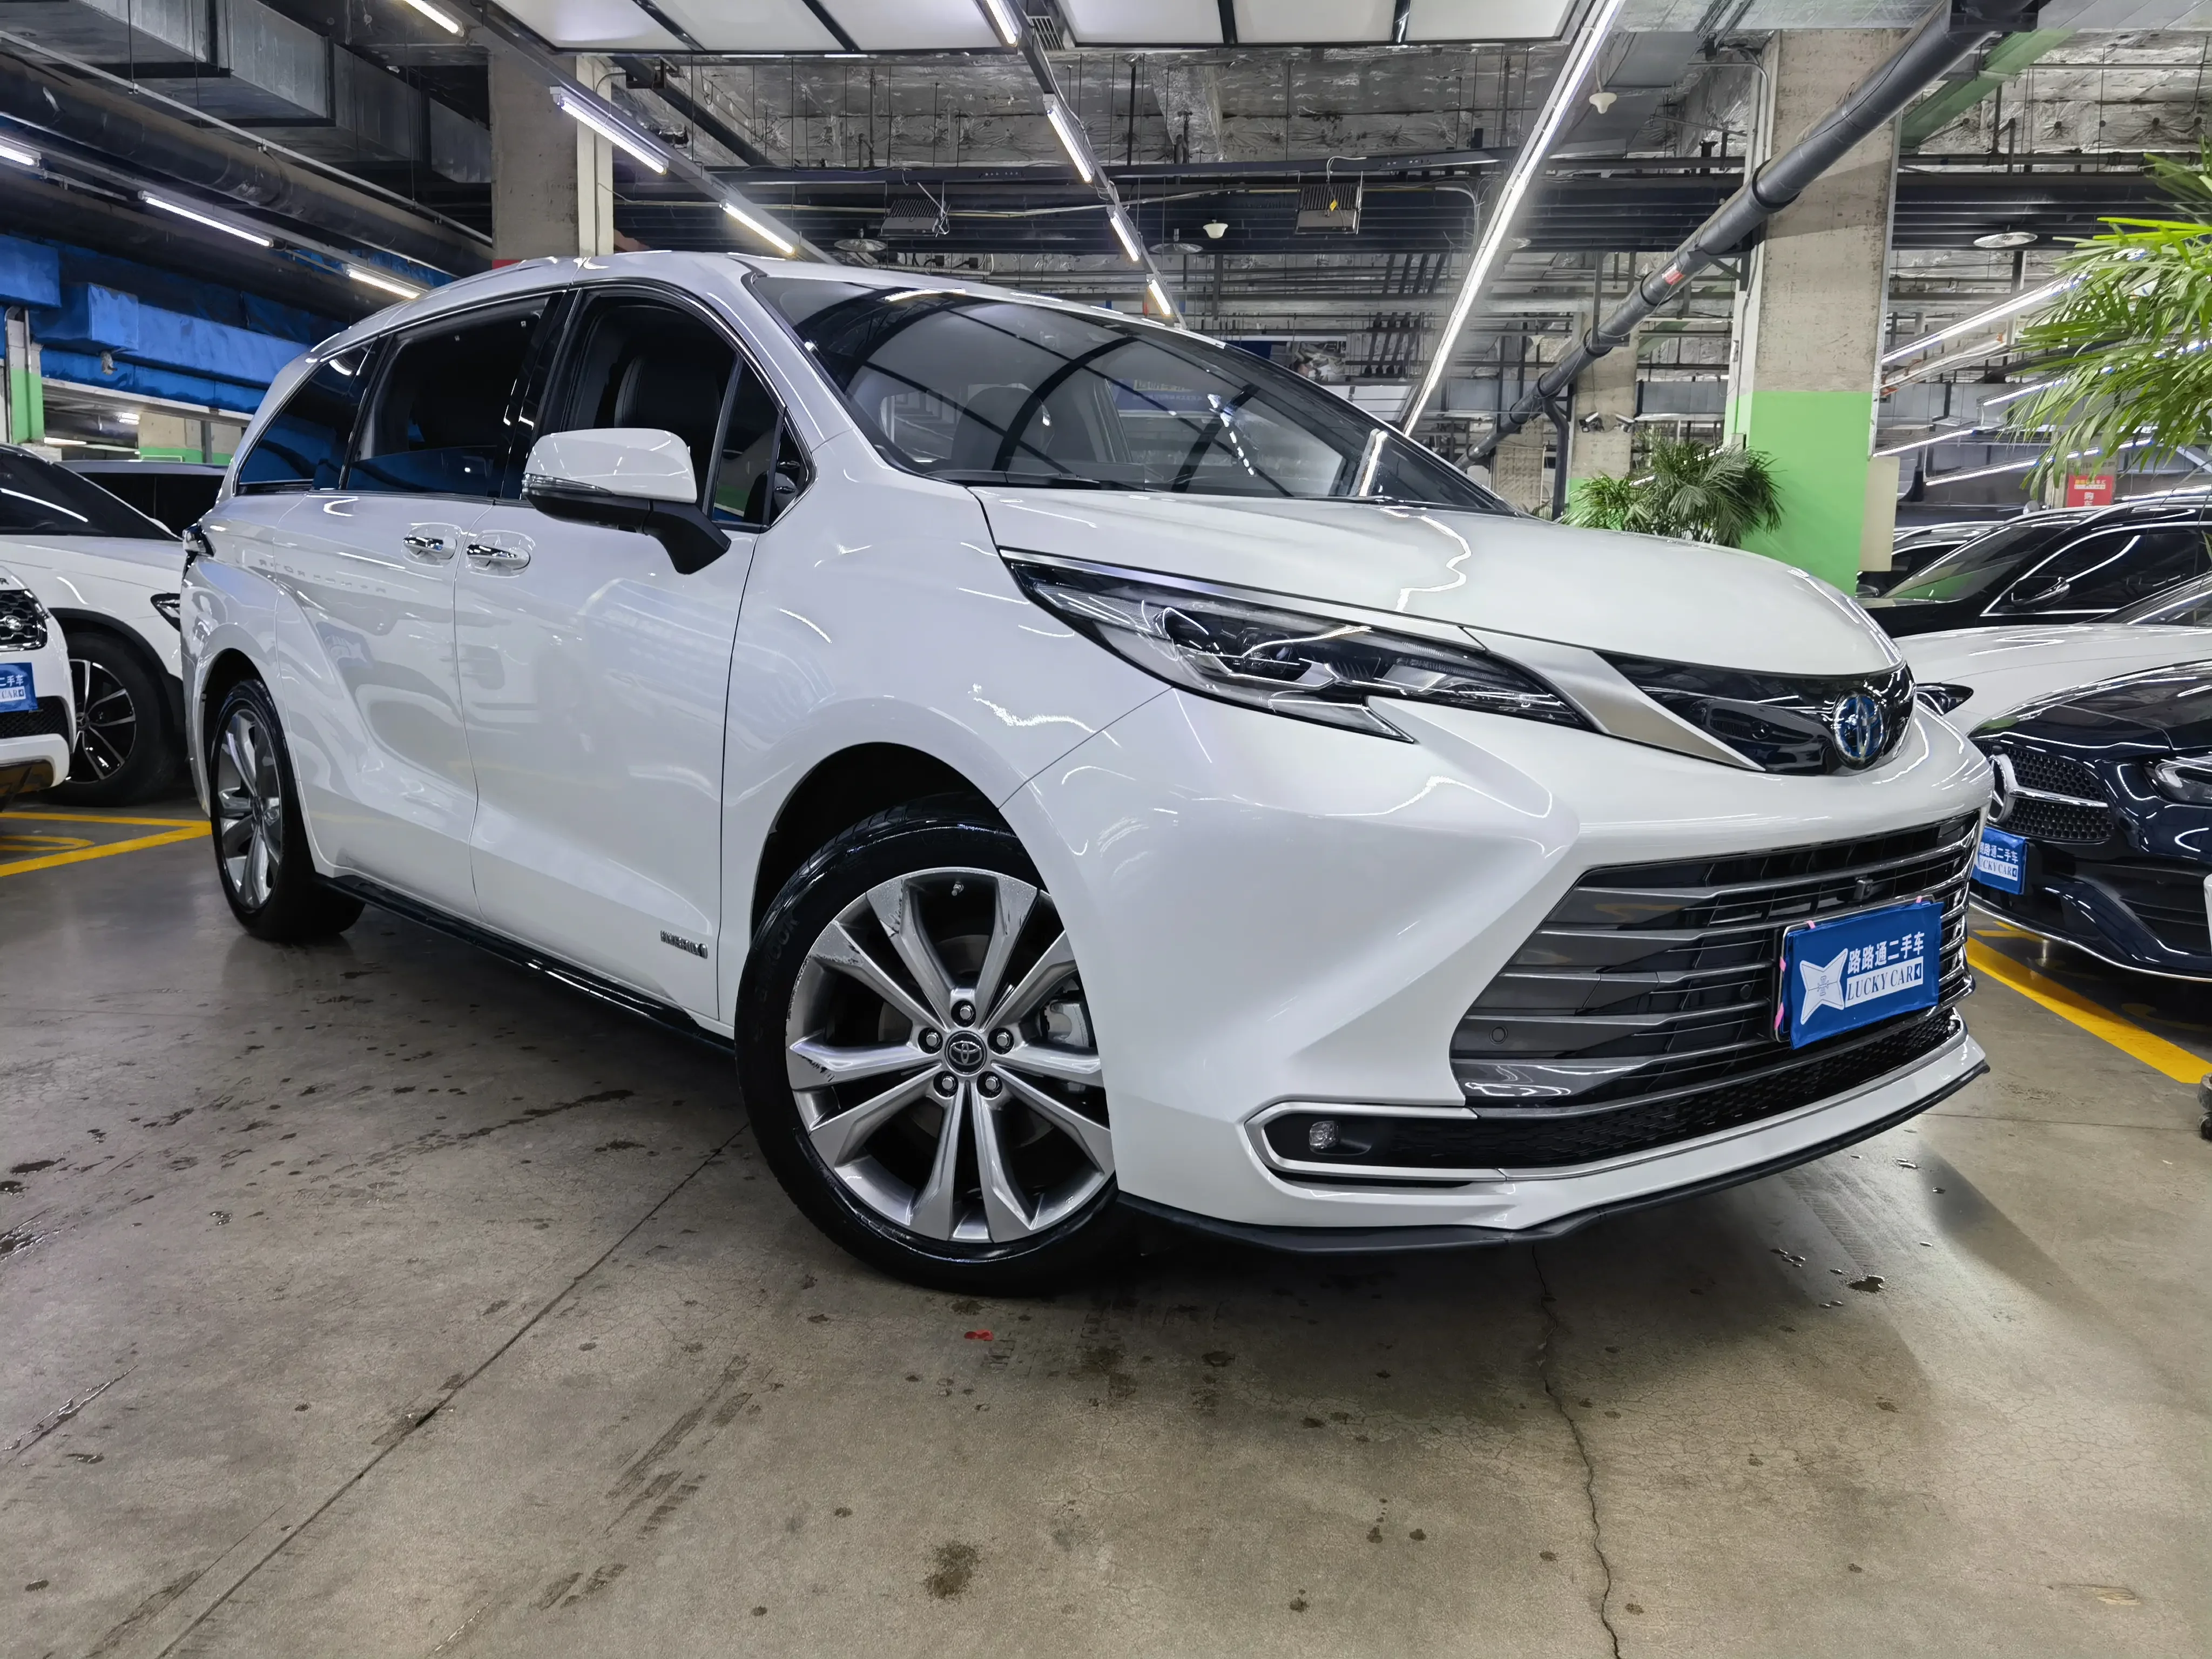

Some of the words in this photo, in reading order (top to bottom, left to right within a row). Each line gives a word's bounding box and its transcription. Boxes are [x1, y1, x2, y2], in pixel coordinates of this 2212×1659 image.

[1998, 864, 2012, 876] CAR
[1847, 931, 1925, 974] 路路通二手车
[1847, 972, 1887, 1001] LUCKY
[1891, 966, 1913, 987] CAR
